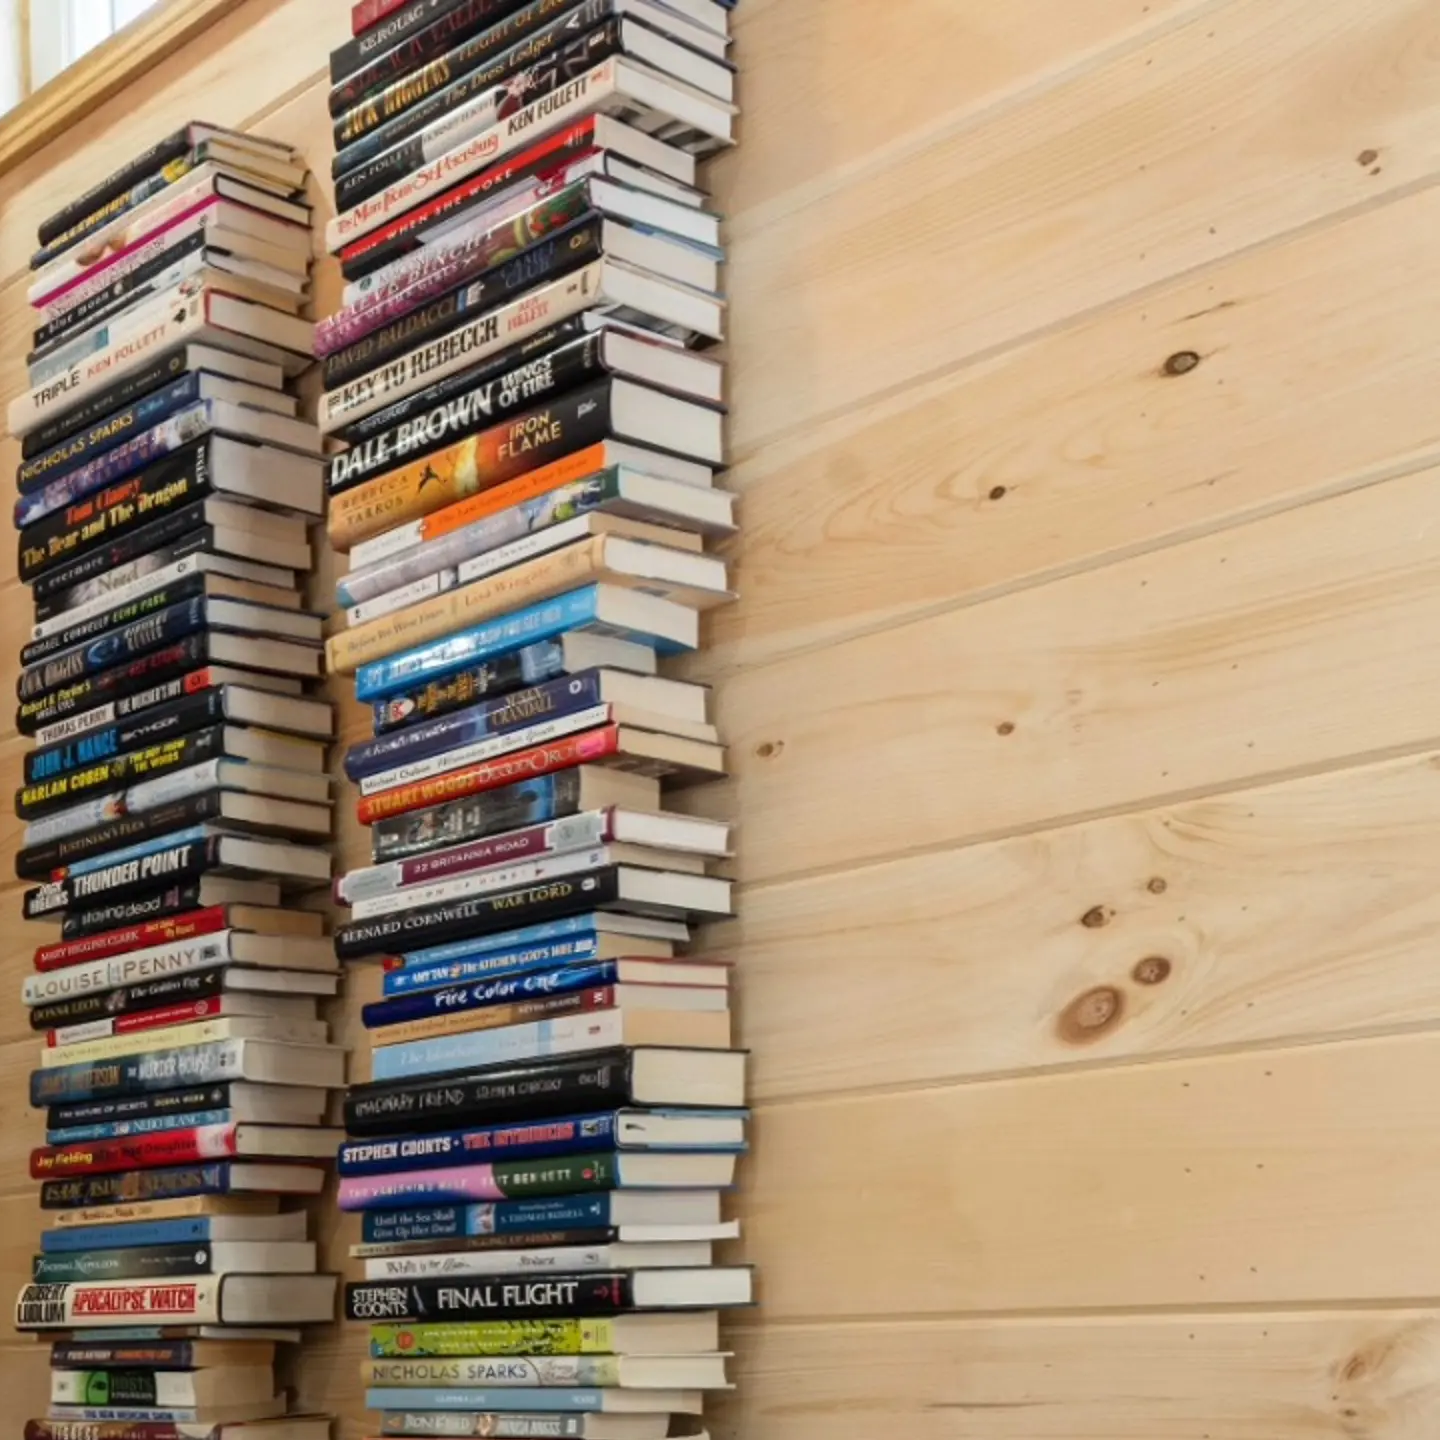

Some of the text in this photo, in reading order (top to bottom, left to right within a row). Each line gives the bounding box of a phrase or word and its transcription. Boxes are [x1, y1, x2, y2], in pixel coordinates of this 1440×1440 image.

[507, 104, 533, 138] KEN
[32, 321, 165, 411] TRIPLE KEN FOLLETT
[331, 382, 491, 487] DALE BROWN
[509, 409, 549, 440] IRON
[21, 408, 132, 485] NICHOLAS SPARKS
[497, 420, 561, 464] FLAME
[21, 776, 67, 807] HARLAN
[73, 844, 192, 898] THUNDER POINT
[529, 881, 572, 903] LORD
[405, 901, 478, 931] CORNWELL
[33, 947, 195, 999] LOUISE PENNY
[433, 985, 466, 1009] Fire
[343, 1141, 398, 1163] STEPHEN
[351, 1284, 407, 1303] STEPHEN
[437, 1279, 578, 1311] FINAL FLIGHT
[372, 1361, 528, 1382] NICHOLAS SPARKS
